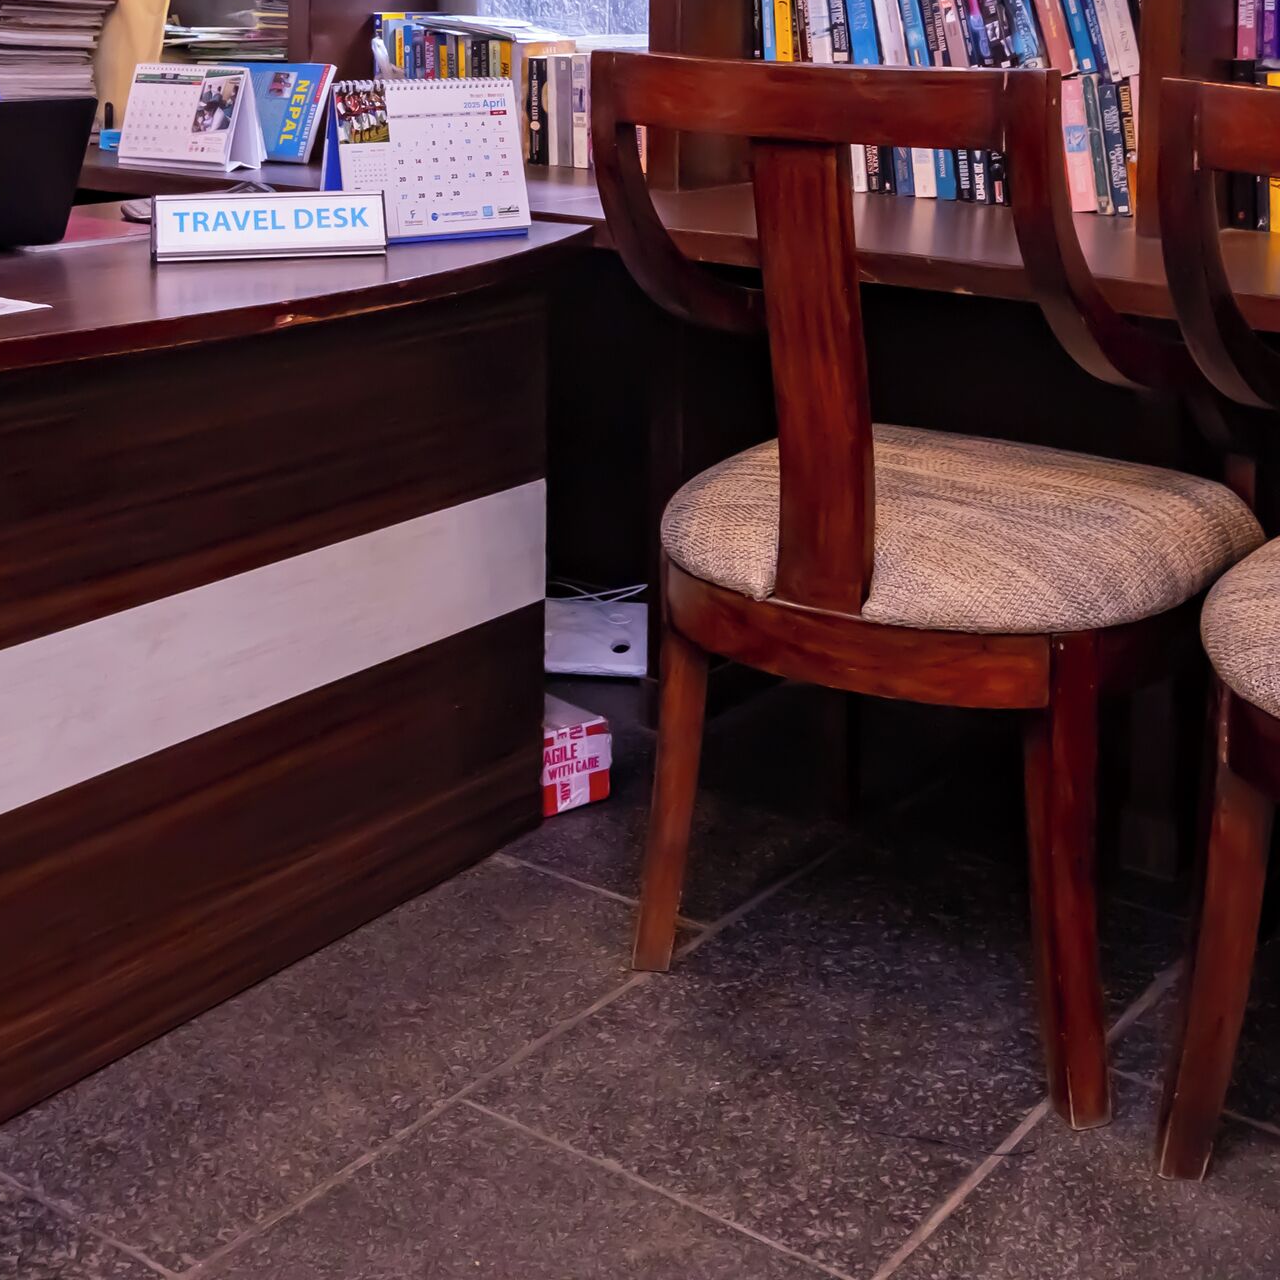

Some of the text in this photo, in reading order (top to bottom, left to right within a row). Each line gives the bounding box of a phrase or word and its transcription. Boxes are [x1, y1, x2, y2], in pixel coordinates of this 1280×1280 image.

[279, 79, 311, 145] NEPAL
[482, 98, 506, 111] April
[173, 206, 369, 233] TRAVEL DESK
[547, 755, 600, 781] WITH CARE
